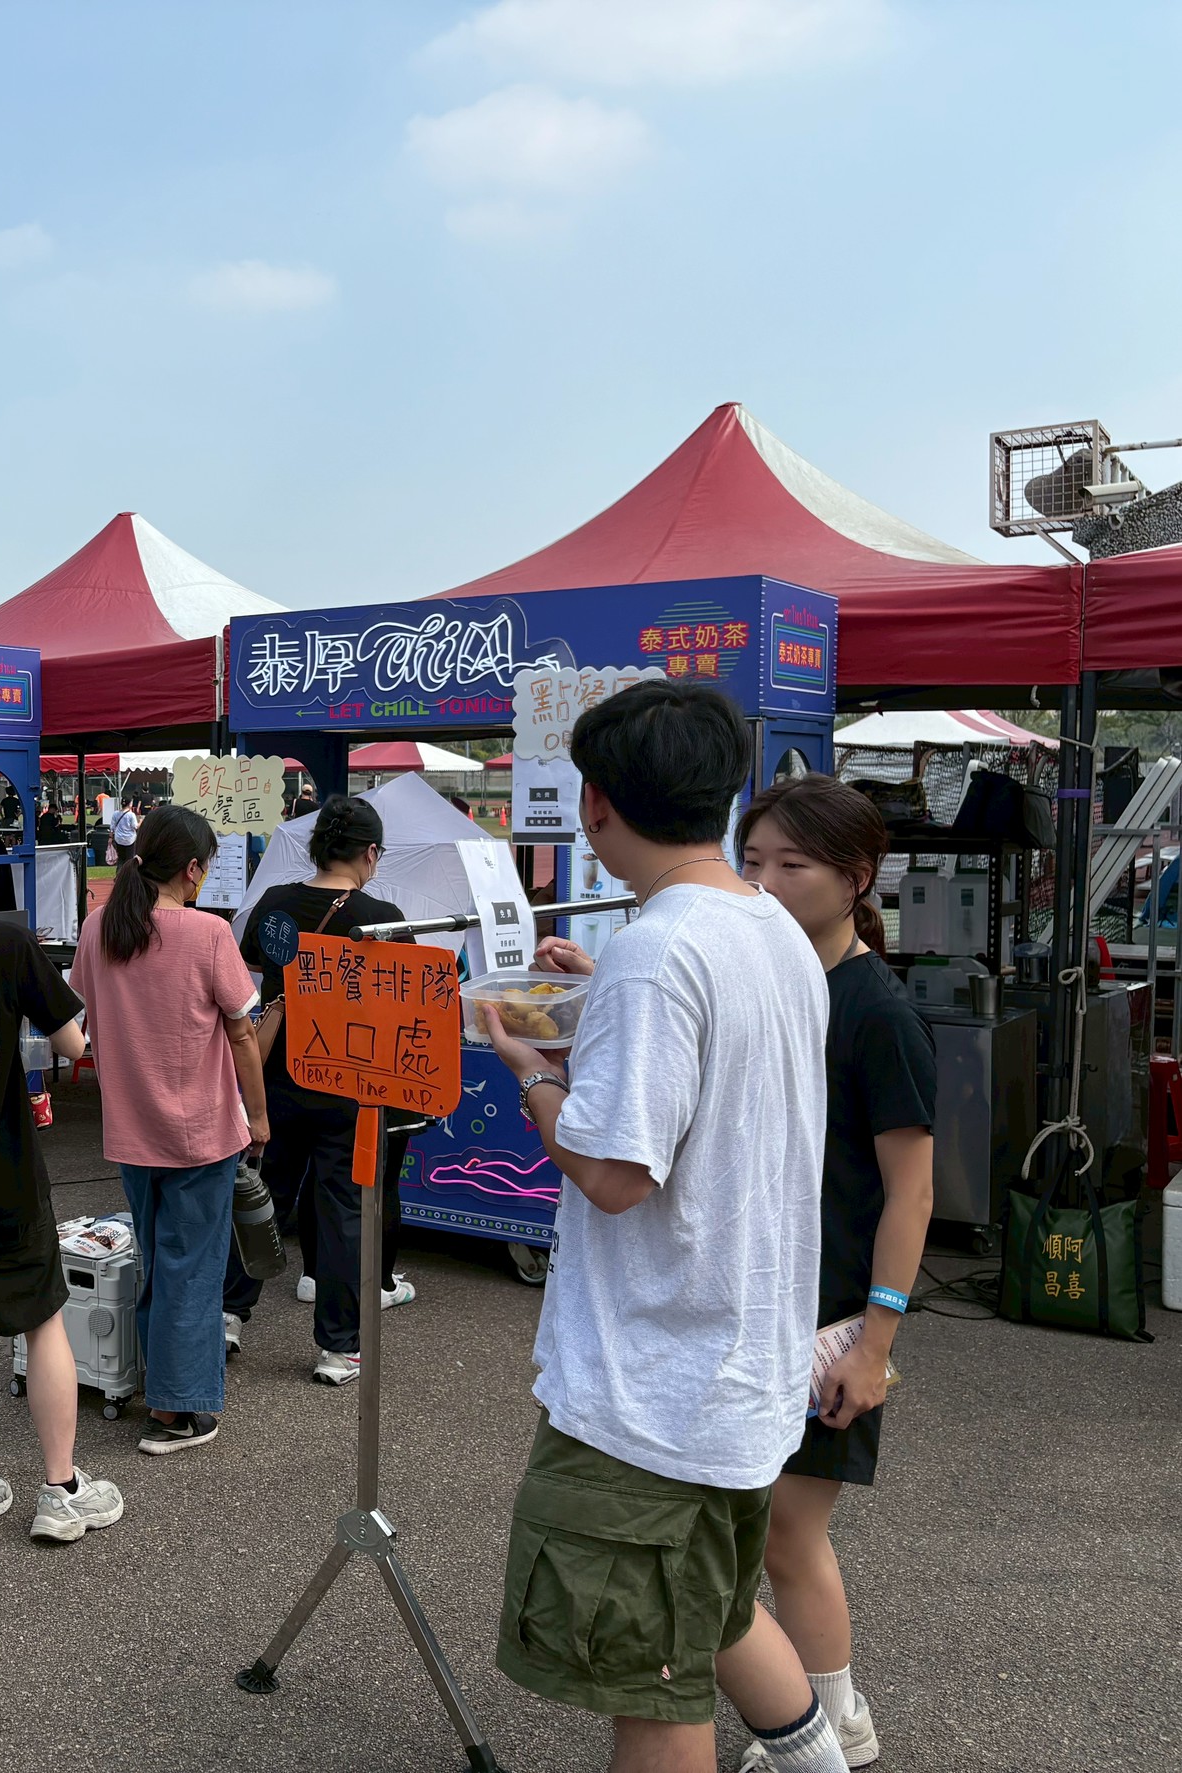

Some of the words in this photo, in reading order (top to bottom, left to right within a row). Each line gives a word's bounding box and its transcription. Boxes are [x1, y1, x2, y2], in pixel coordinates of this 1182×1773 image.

[639, 623, 748, 651] 泰式奶茶
[667, 654, 718, 677] 專賣
[778, 640, 822, 669] 泰式奶茶專賣
[329, 703, 364, 719] LET
[370, 701, 430, 718] CHILL
[192, 760, 259, 798] 飲品
[297, 944, 456, 1010] 點餐排隊
[304, 1018, 440, 1080] 入口處
[293, 1058, 345, 1090] Please
[356, 1072, 389, 1099] line
